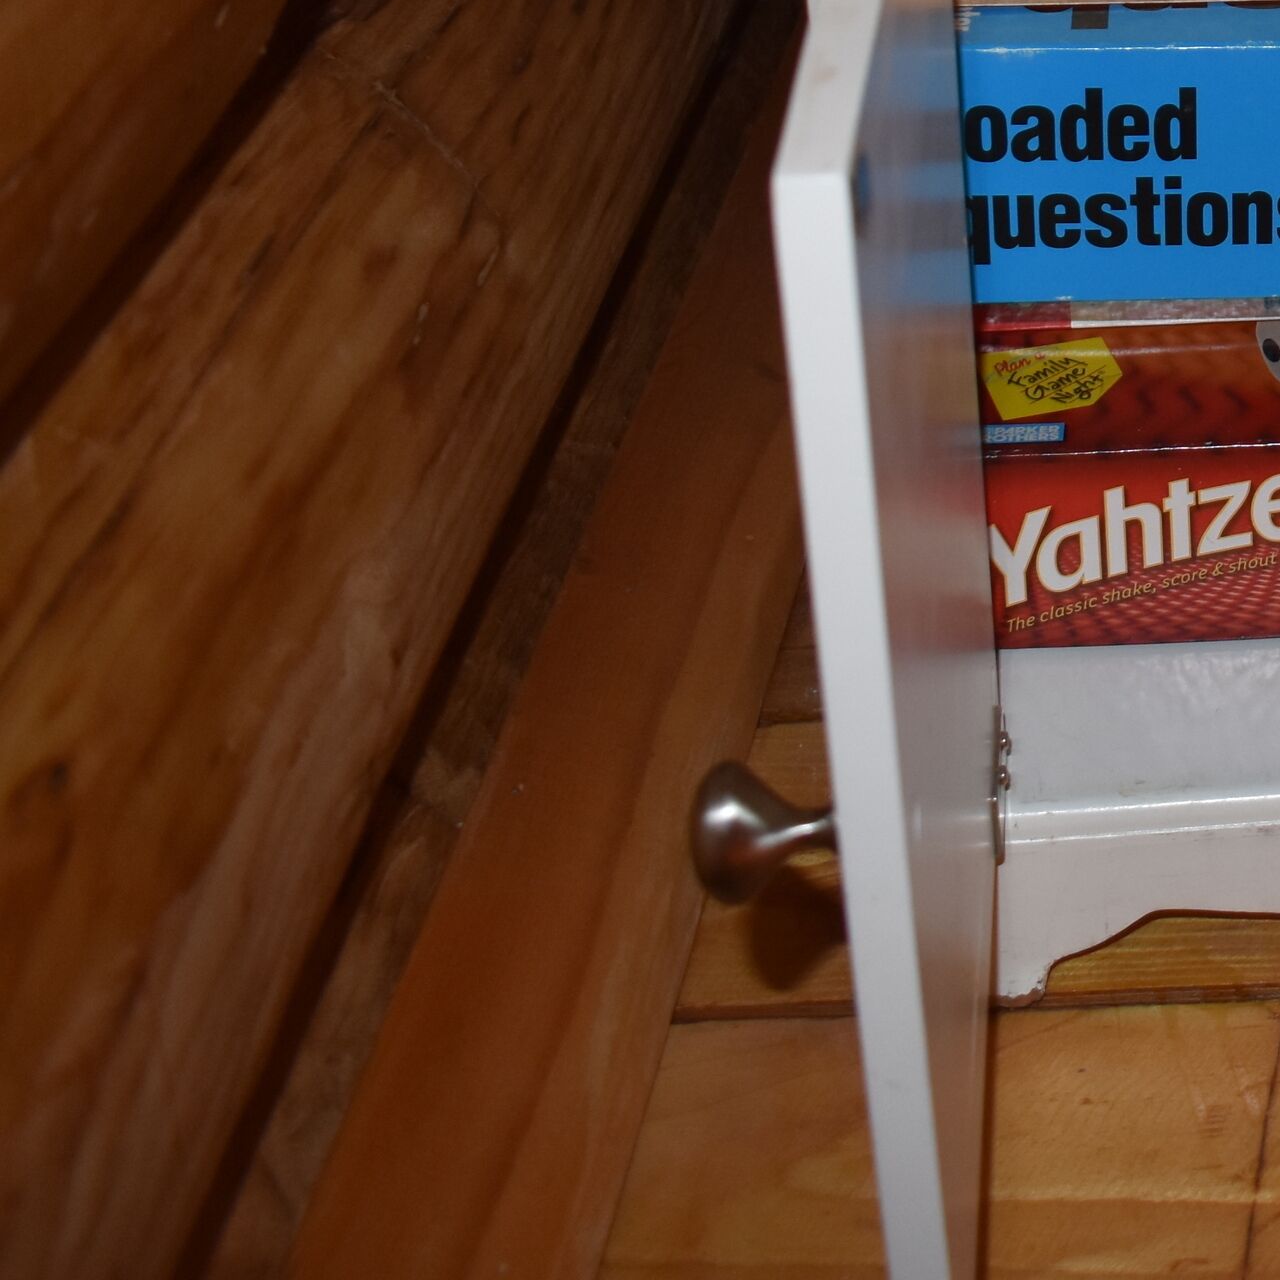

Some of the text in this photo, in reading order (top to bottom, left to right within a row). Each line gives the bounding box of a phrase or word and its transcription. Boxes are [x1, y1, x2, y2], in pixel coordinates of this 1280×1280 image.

[994, 357, 1032, 376] Plan
[1008, 357, 1089, 387] Family
[1025, 367, 1086, 401] Game
[1051, 371, 1105, 403] Night
[1008, 613, 1035, 633] The
[1040, 595, 1098, 623] classic
[1102, 581, 1157, 605] shake,
[1162, 568, 1208, 590] score
[1212, 562, 1224, 577] &
[1229, 553, 1277, 574] shout
